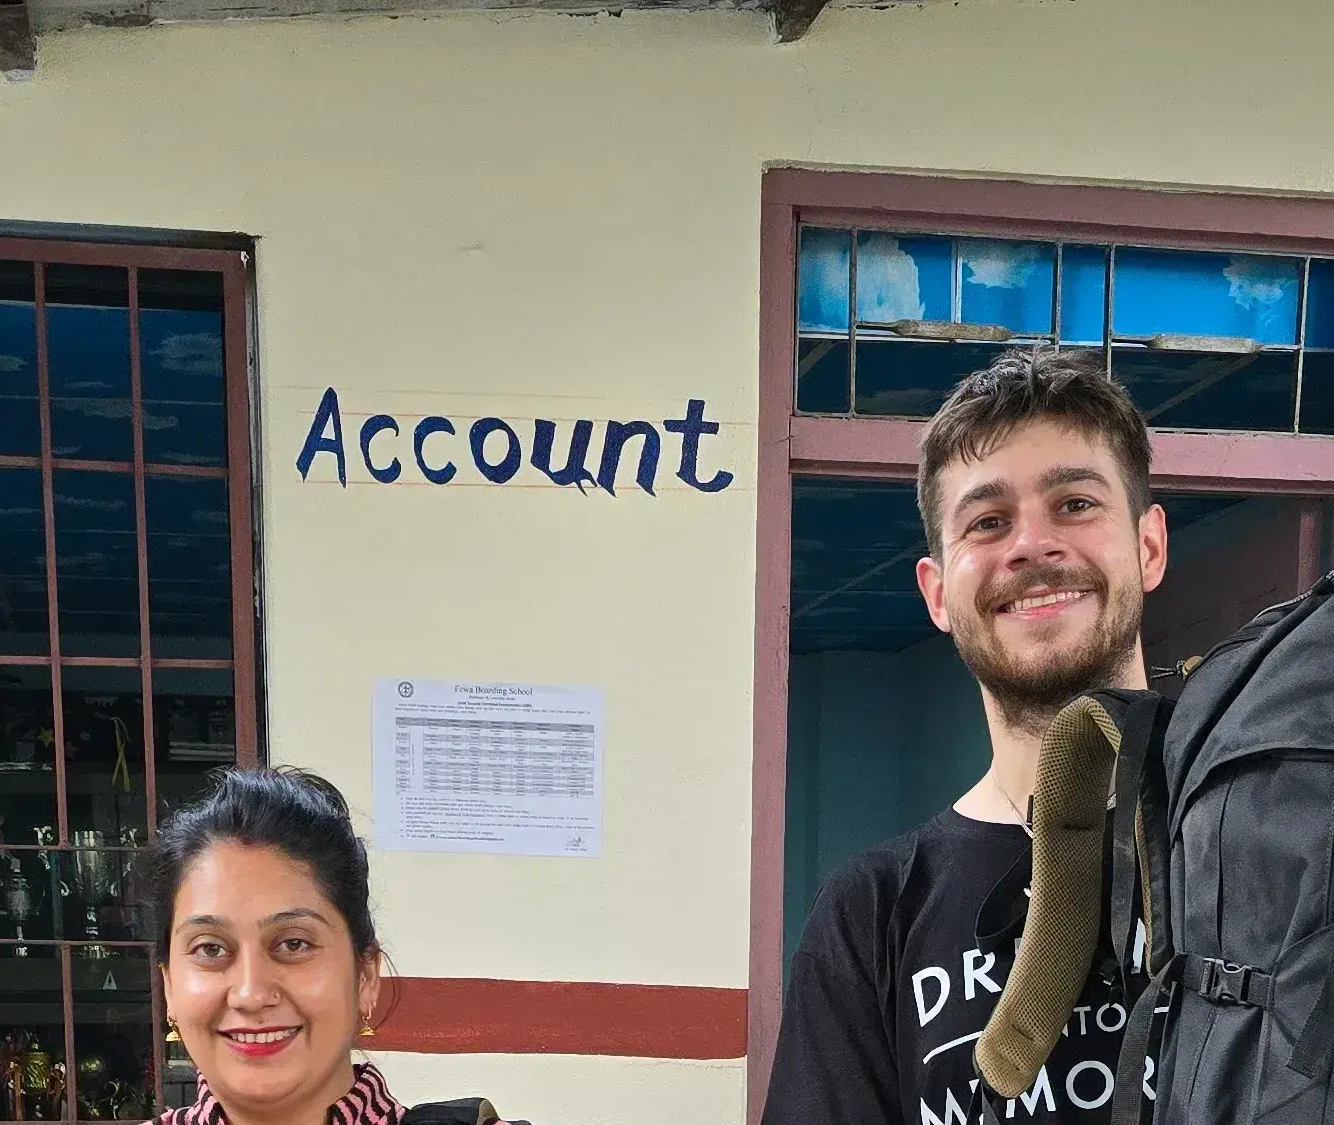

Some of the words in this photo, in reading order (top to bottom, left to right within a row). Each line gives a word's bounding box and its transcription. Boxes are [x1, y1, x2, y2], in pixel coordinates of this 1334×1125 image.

[295, 386, 734, 498] Account
[475, 685, 508, 696] Boarding
[508, 687, 533, 696] School
